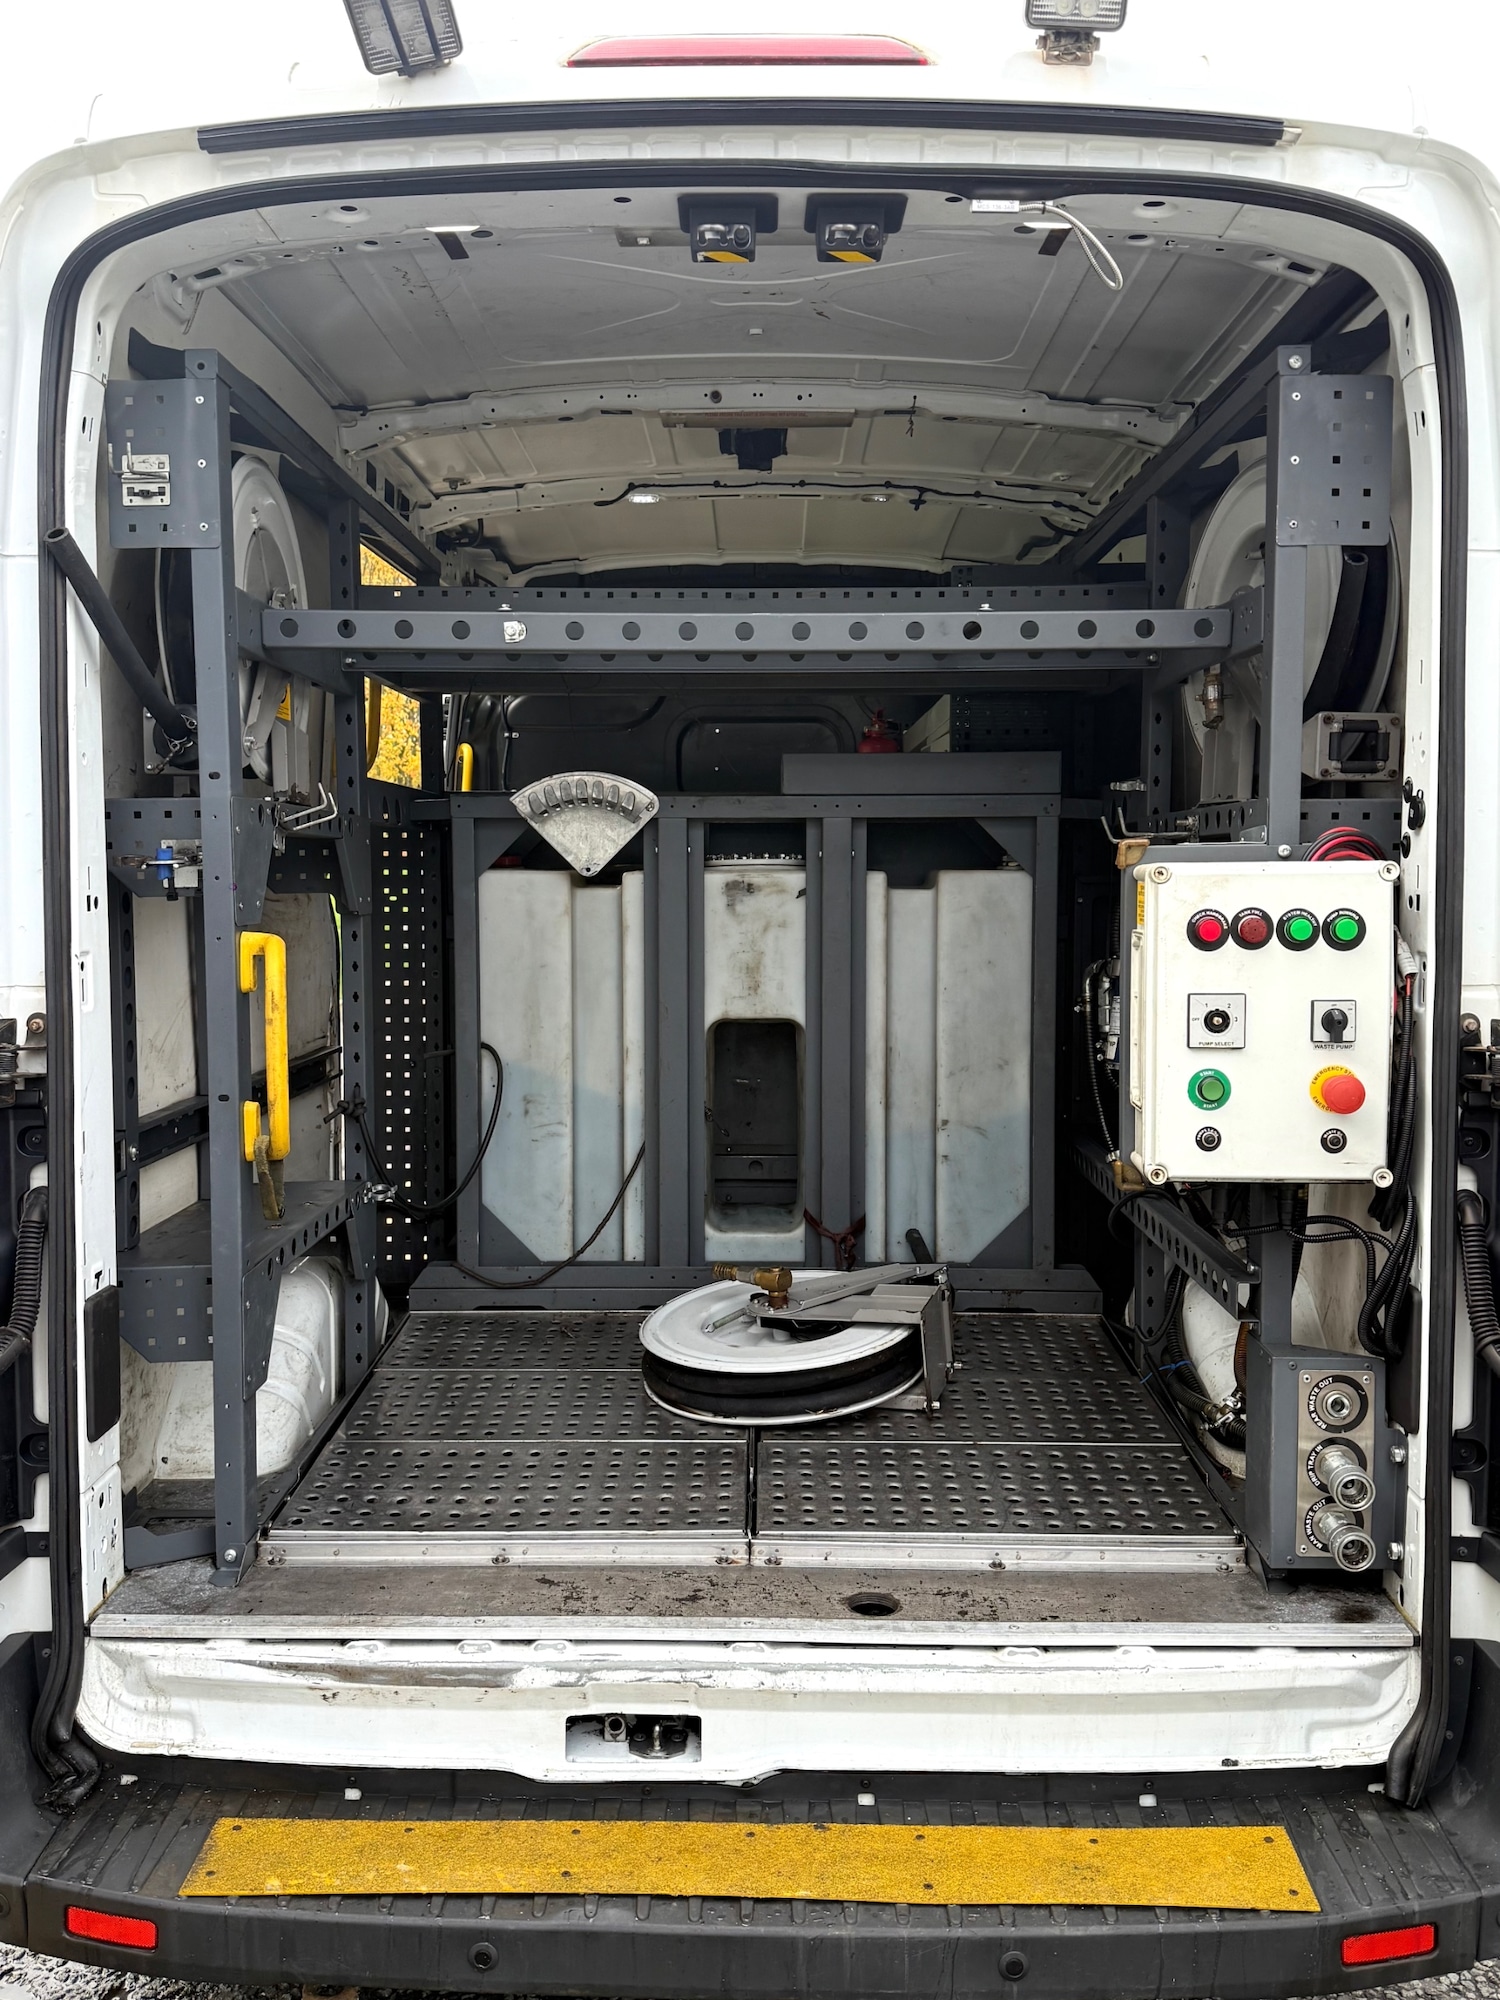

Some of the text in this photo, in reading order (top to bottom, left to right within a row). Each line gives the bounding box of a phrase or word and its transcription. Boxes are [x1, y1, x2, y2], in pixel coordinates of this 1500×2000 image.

[1312, 1066, 1344, 1085] EMERGENCY
[1308, 1377, 1333, 1429] REAR WASTE OUT
[1307, 1444, 1323, 1487] DRIP TRAY IN
[1305, 1499, 1326, 1549] MAN WASTE OUT
